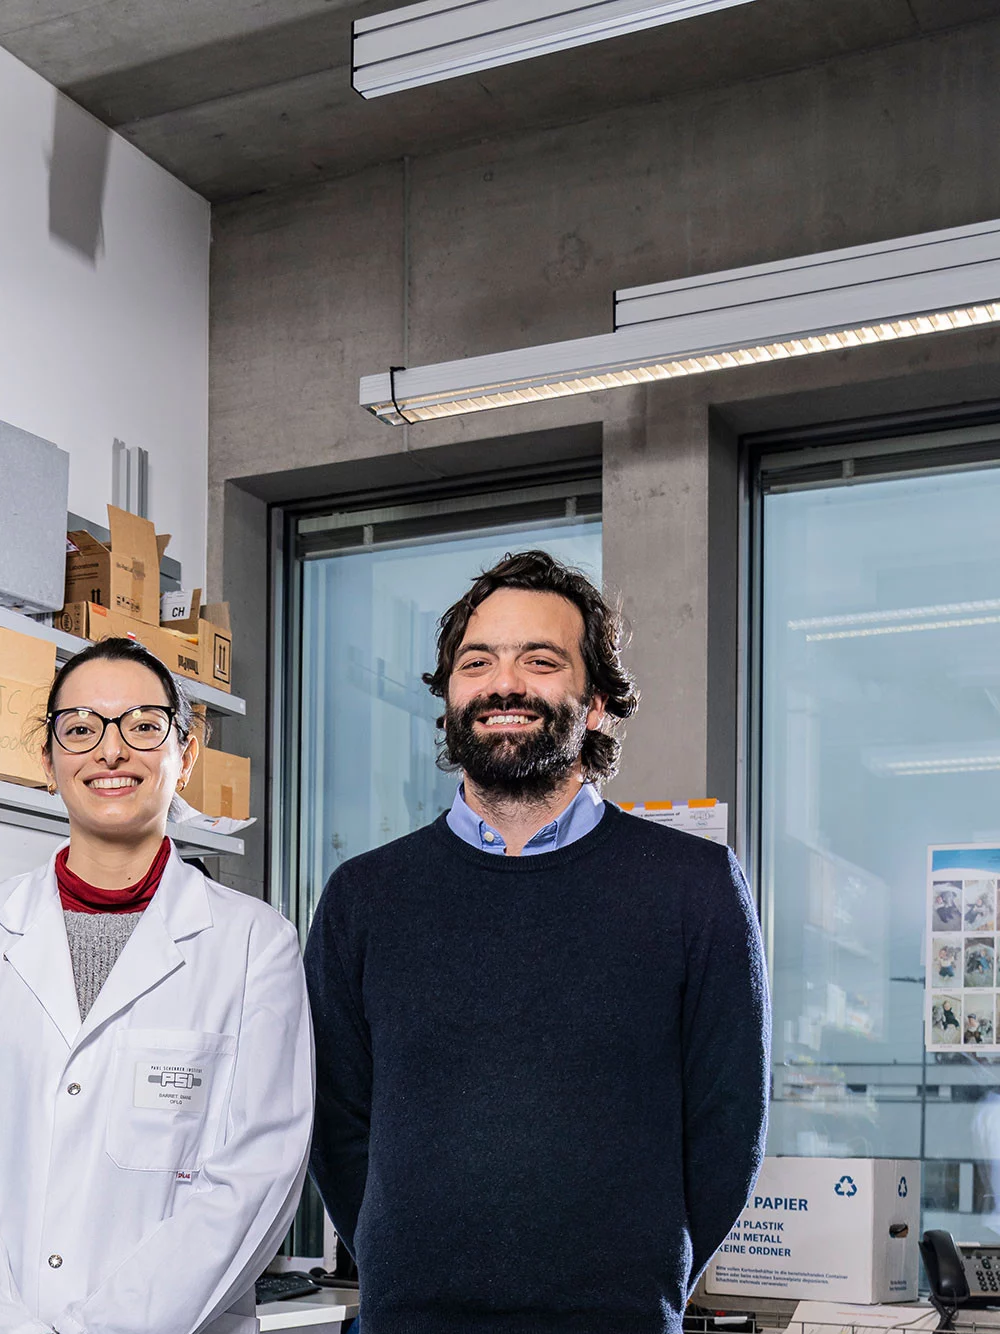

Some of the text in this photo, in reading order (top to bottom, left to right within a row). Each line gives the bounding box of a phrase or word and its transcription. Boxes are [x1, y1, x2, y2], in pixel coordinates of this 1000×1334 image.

[172, 607, 185, 618] CH
[161, 1072, 194, 1089] PSI
[754, 1196, 808, 1212] PAPIER
[743, 1220, 784, 1231] PLASTIK
[743, 1233, 782, 1244] METALL
[748, 1246, 791, 1257] ORDNER
